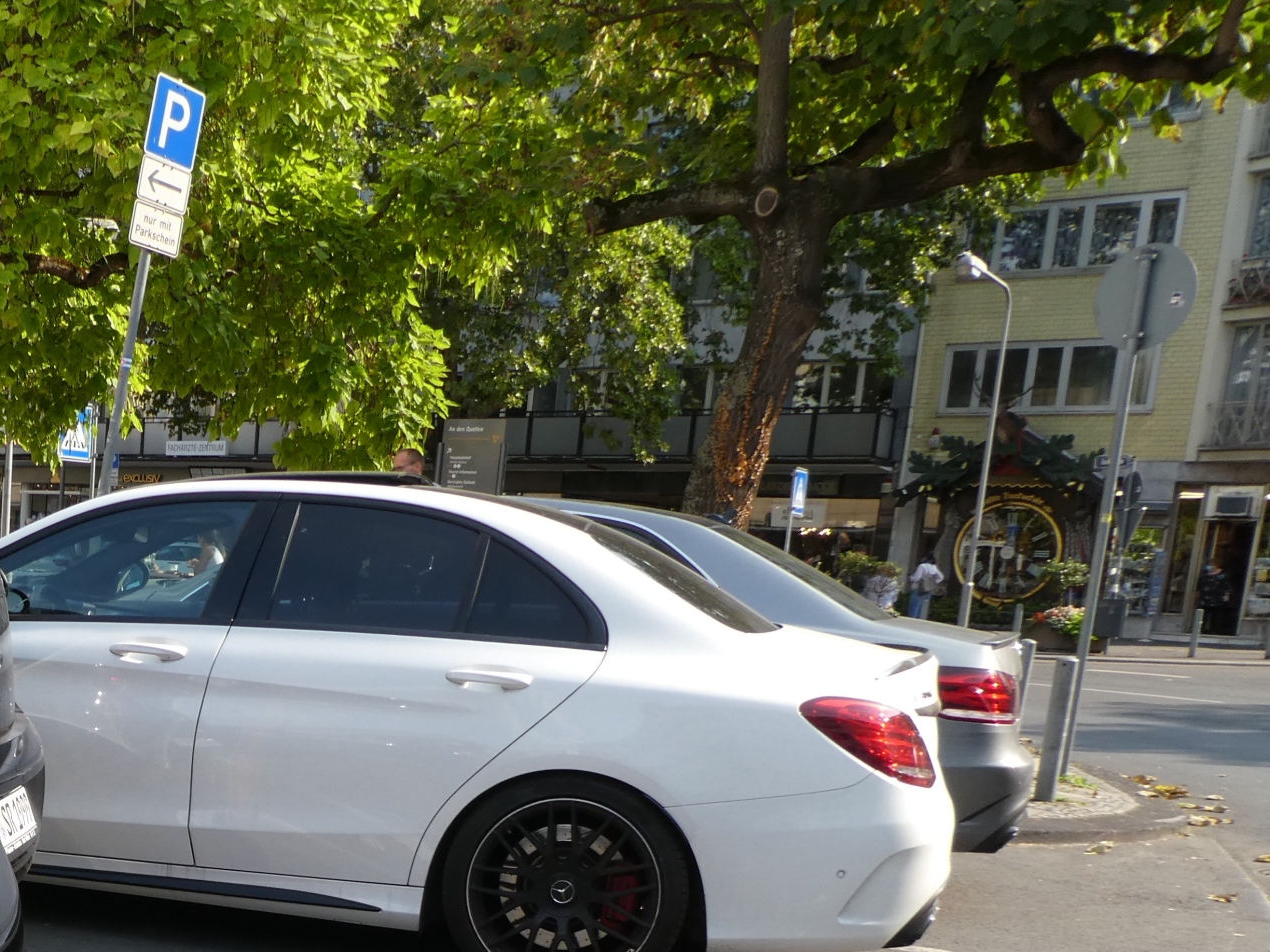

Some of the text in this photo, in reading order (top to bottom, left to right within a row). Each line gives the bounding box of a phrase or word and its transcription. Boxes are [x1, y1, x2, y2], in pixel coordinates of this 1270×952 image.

[157, 89, 191, 149] P
[143, 213, 172, 232] nur mit
[134, 224, 176, 247] Parkschein
